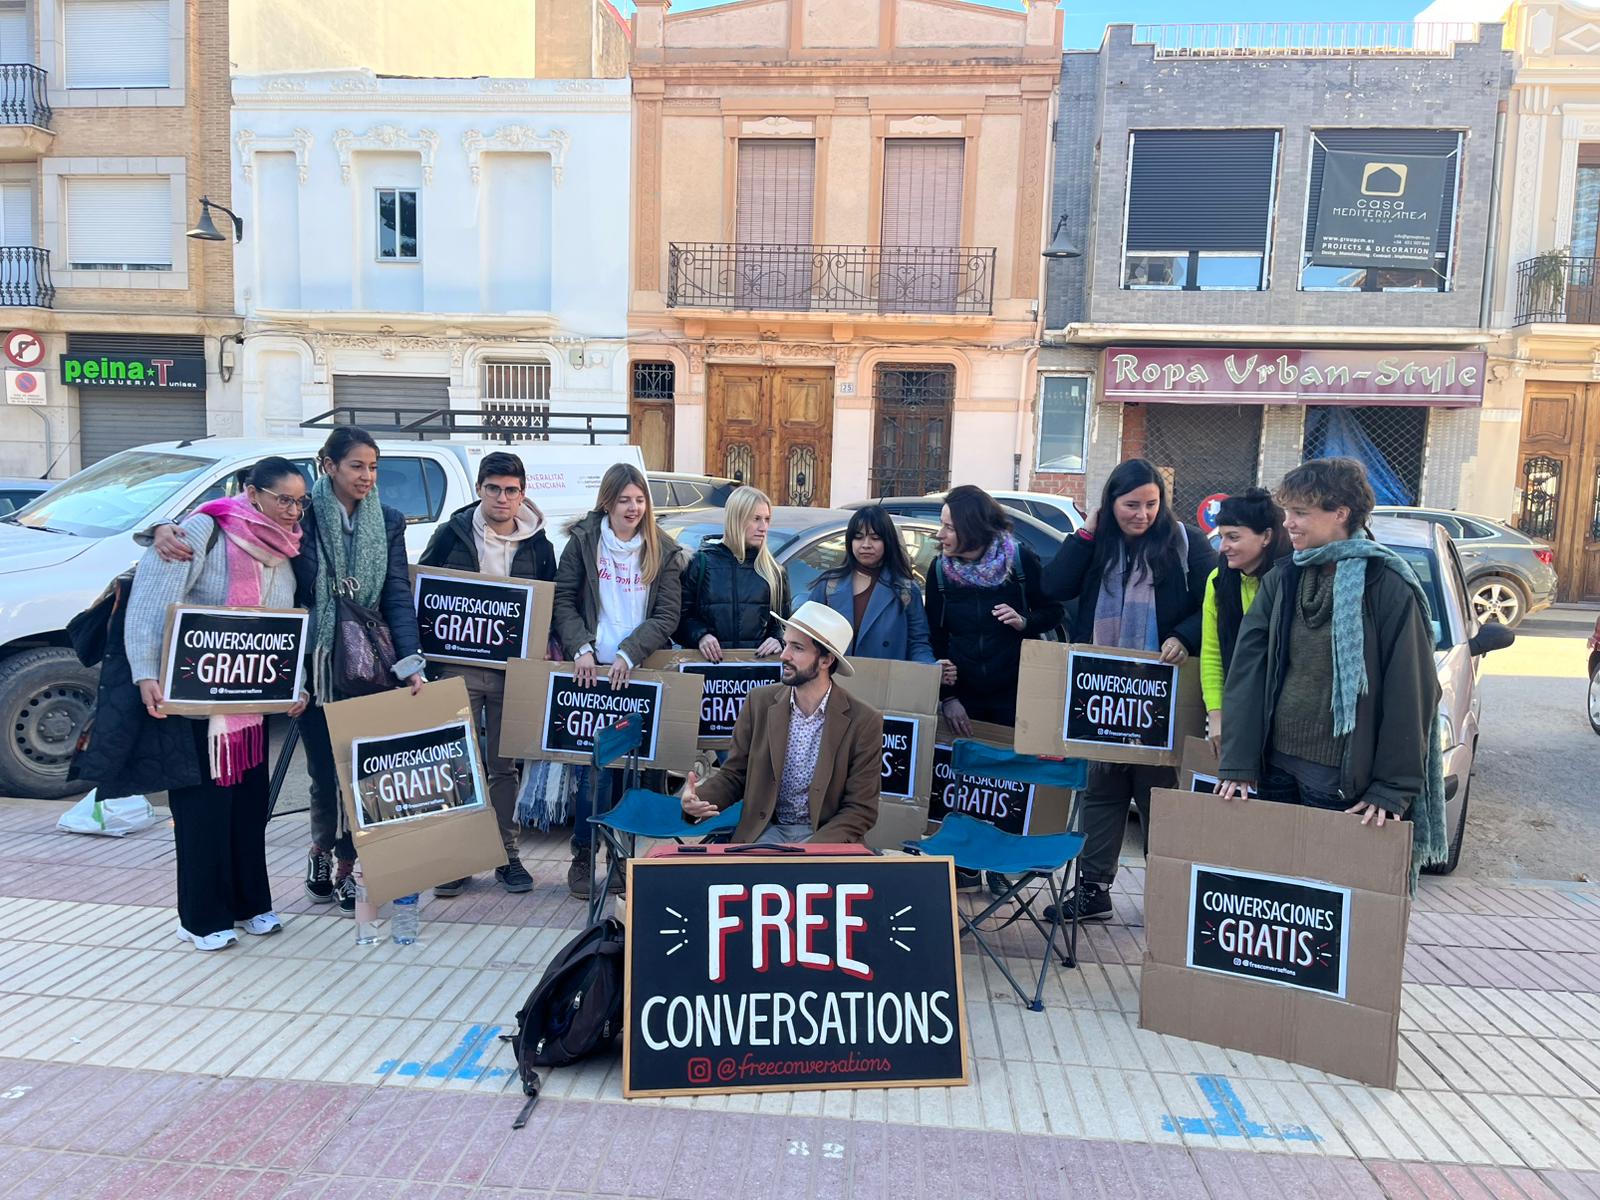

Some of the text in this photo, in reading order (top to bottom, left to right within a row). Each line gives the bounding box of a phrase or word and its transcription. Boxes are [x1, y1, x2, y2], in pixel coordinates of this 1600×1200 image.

[1332, 207, 1427, 220] MEDITERRANEA
[1356, 198, 1404, 210] casa
[1321, 242, 1430, 255] PROJECTS & DECORATION
[64, 357, 145, 383] peina
[75, 378, 198, 388] PELUQUERIA unisex
[1112, 354, 1209, 390] Ropa
[526, 473, 564, 481] ENERALITAT
[424, 593, 520, 618] CONVERSACIONES
[184, 630, 295, 651] CONVERSACIONES
[434, 613, 505, 646] GRATIS
[197, 652, 279, 684] GRATIS
[1076, 672, 1168, 697] CONVERSACIONES
[557, 690, 651, 714] CONVERSACIONES
[700, 697, 746, 722] GRAT
[1086, 695, 1154, 729] GRATIS
[567, 710, 623, 737] GRAT
[363, 741, 464, 774] CONVERSACIONES
[379, 763, 454, 803] GRATIS
[943, 783, 1010, 818] GRATIS
[1202, 890, 1334, 932] CONVERSACIONES
[708, 883, 874, 983] FREE
[1218, 917, 1314, 967] GRATIS
[640, 990, 954, 1051] CONVERSATIONS
[716, 1052, 892, 1082] @freeconversations
